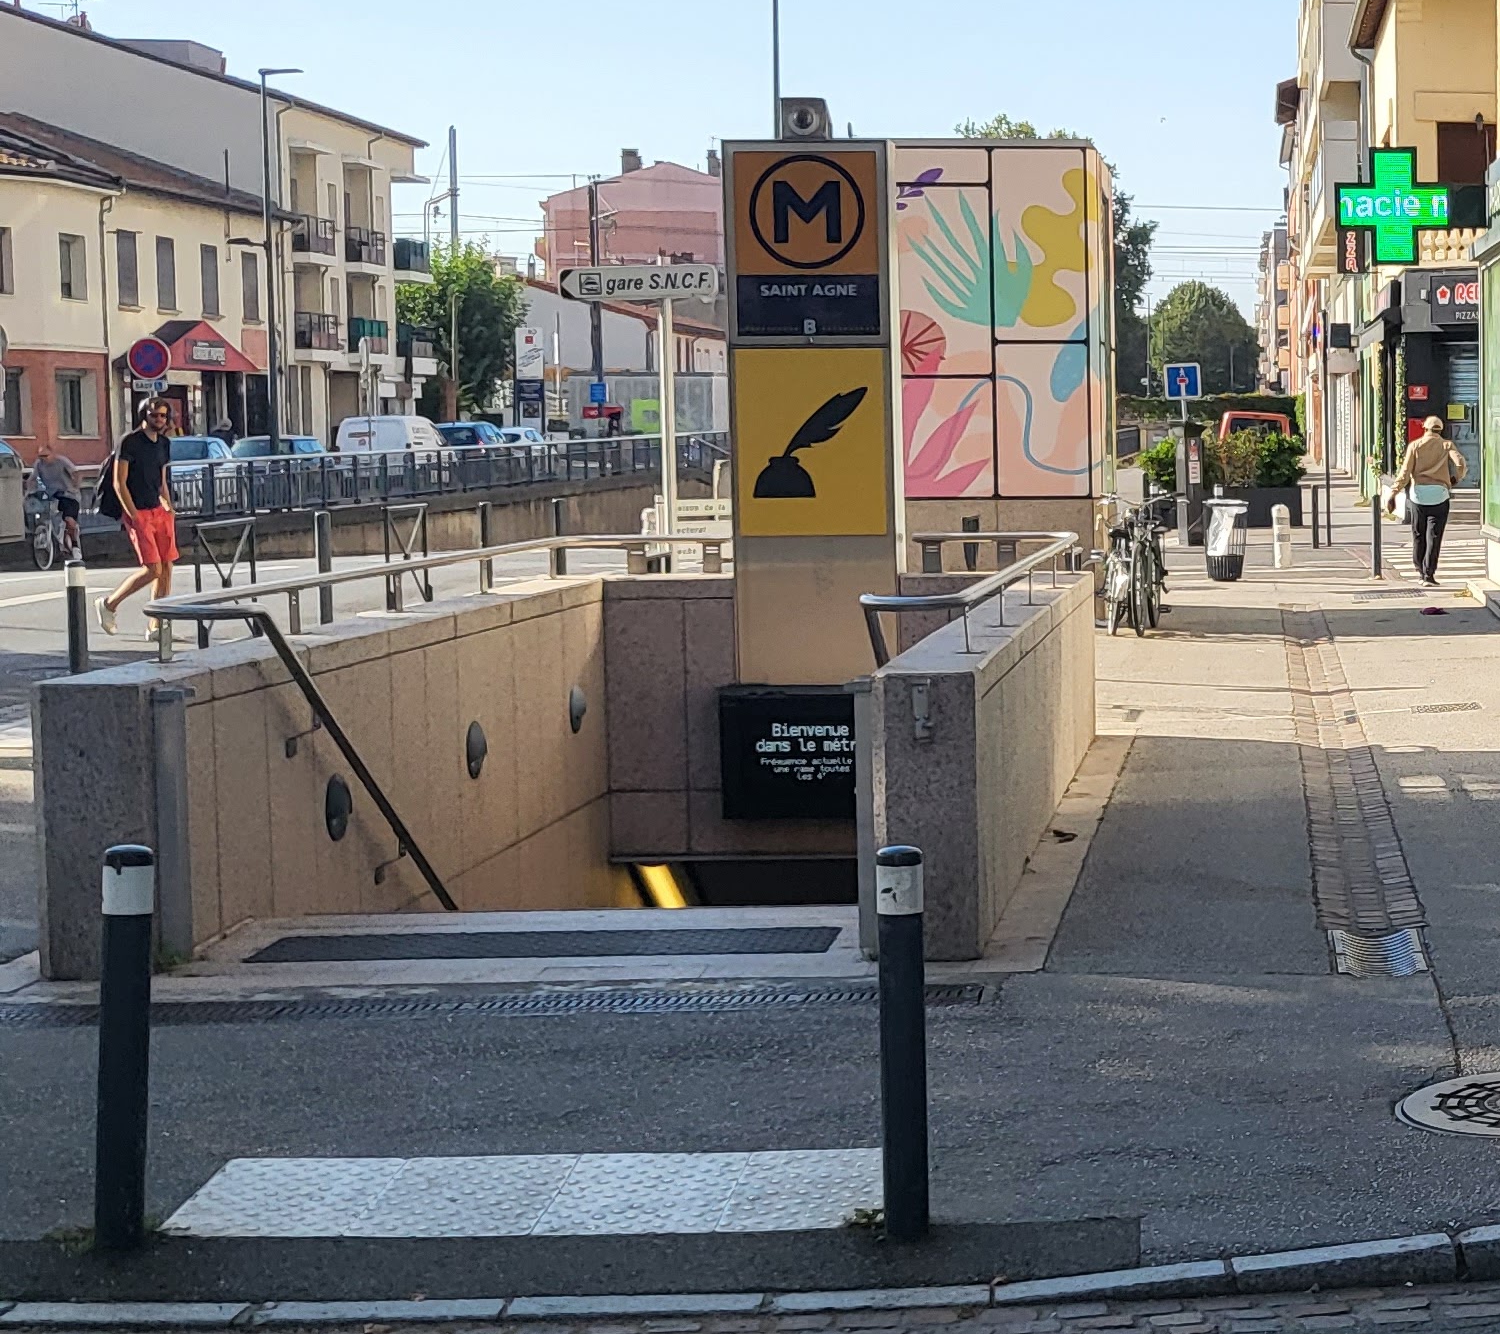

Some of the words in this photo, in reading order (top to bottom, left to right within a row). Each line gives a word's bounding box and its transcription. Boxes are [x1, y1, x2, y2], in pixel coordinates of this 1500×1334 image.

[772, 180, 842, 244] M
[605, 278, 644, 296] gare
[648, 271, 712, 290] S.N.C.F.
[760, 283, 808, 297] SAINT
[811, 283, 858, 297] AGNE
[803, 318, 817, 335] B
[771, 722, 850, 737] Bienvenue
[755, 738, 792, 753] dans
[797, 737, 817, 752] le
[822, 737, 857, 752] métr
